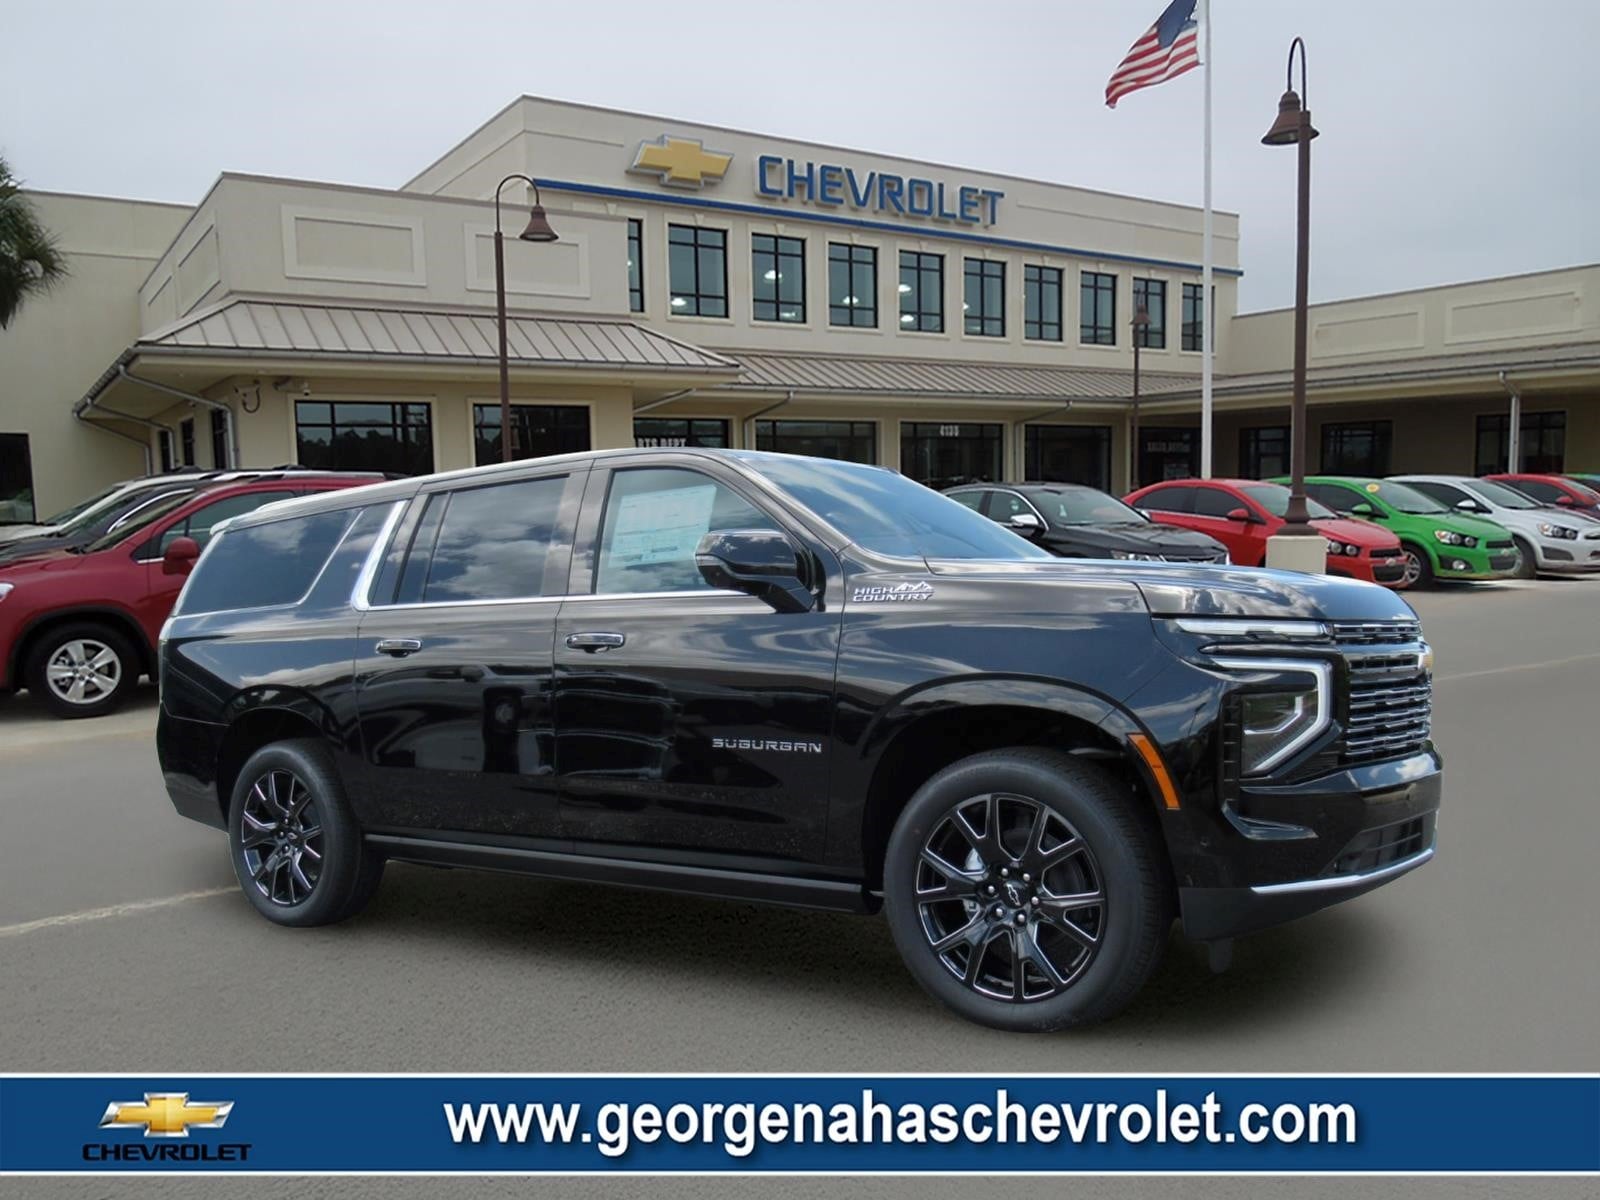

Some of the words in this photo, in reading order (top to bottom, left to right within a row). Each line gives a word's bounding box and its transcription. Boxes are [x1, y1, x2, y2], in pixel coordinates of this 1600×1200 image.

[757, 154, 1005, 226] CHEVROLET
[854, 586, 896, 595] HIGH
[853, 594, 934, 602] COUNTRY
[712, 738, 822, 753] SUBURBAN
